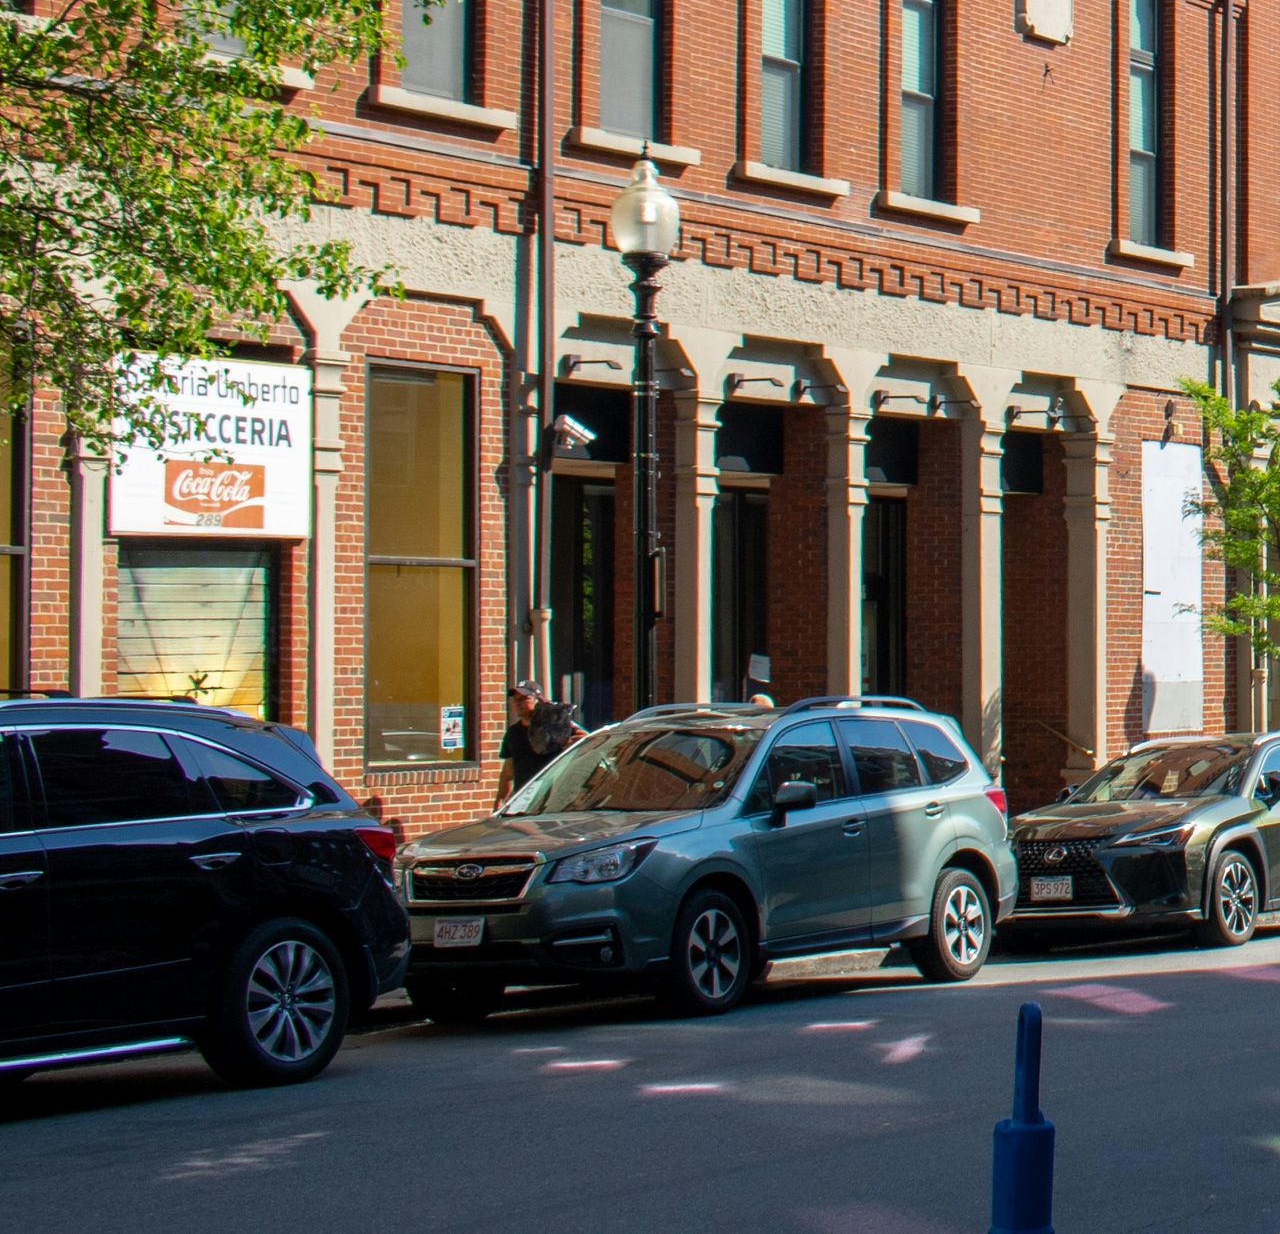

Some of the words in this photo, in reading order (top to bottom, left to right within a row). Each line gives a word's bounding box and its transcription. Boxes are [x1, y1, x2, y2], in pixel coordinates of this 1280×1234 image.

[195, 513, 222, 527] 289
[1035, 883, 1052, 894] 3PS
[1053, 883, 1071, 894] 972
